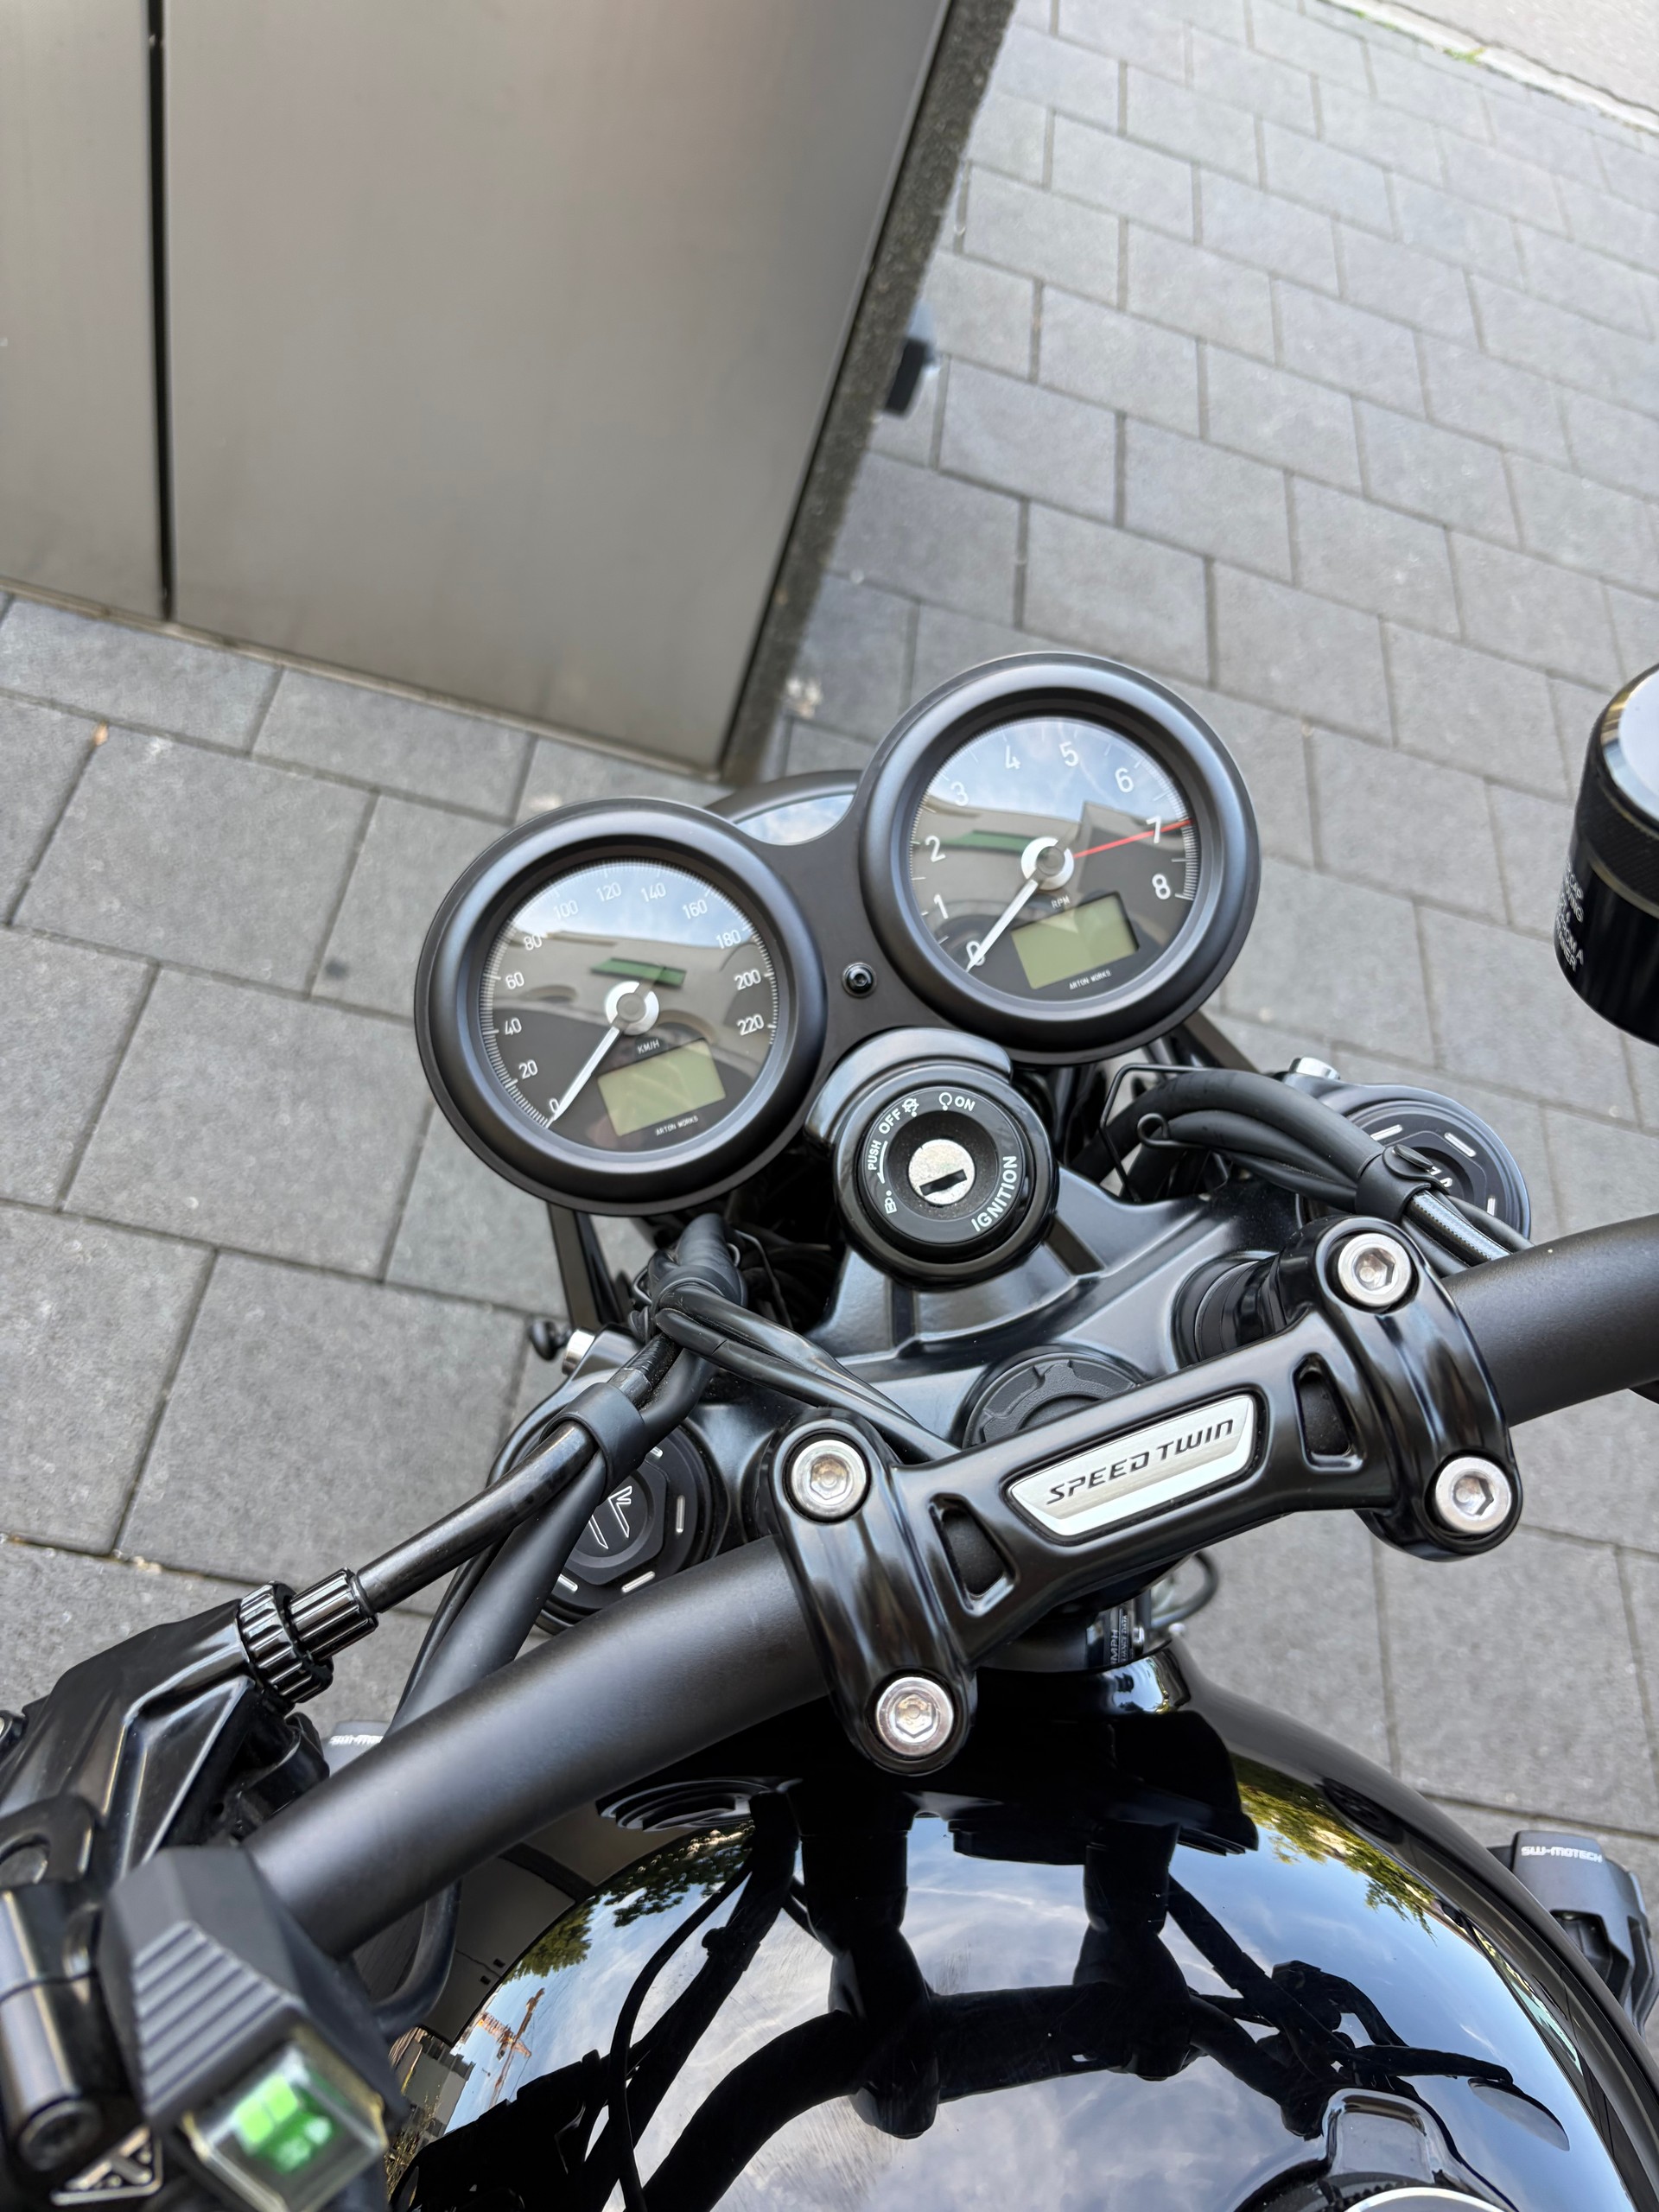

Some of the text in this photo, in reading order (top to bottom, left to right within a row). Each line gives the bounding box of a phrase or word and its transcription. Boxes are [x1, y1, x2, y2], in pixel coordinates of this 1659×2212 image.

[1005, 747, 1020, 770] 4
[1059, 743, 1079, 766] 5
[1115, 767, 1134, 792] 6
[951, 782, 969, 806] 3
[1146, 816, 1162, 843] 7
[925, 836, 945, 861] 2
[596, 882, 622, 903] 120
[641, 883, 666, 903] 140
[1152, 874, 1170, 899] 8
[554, 900, 579, 919] 100
[683, 900, 709, 919] 160
[934, 895, 948, 918] 1
[1051, 894, 1071, 909] RPM
[524, 934, 543, 950] 80
[716, 930, 741, 949] 180
[505, 972, 524, 989] 60
[734, 969, 761, 990] 200
[505, 1018, 522, 1035] 40
[737, 1014, 764, 1035] 220
[638, 1039, 660, 1054] KM/H
[519, 1059, 538, 1079] 20
[550, 1098, 560, 1113] 0
[955, 1096, 976, 1111] ON
[879, 1109, 902, 1134] OFF
[868, 1140, 882, 1171] PUSH
[971, 1155, 1018, 1232] IGNITION
[1046, 1419, 1234, 1505] SPEED TWIN
[1520, 1846, 1603, 1863] SW-MOTECH
